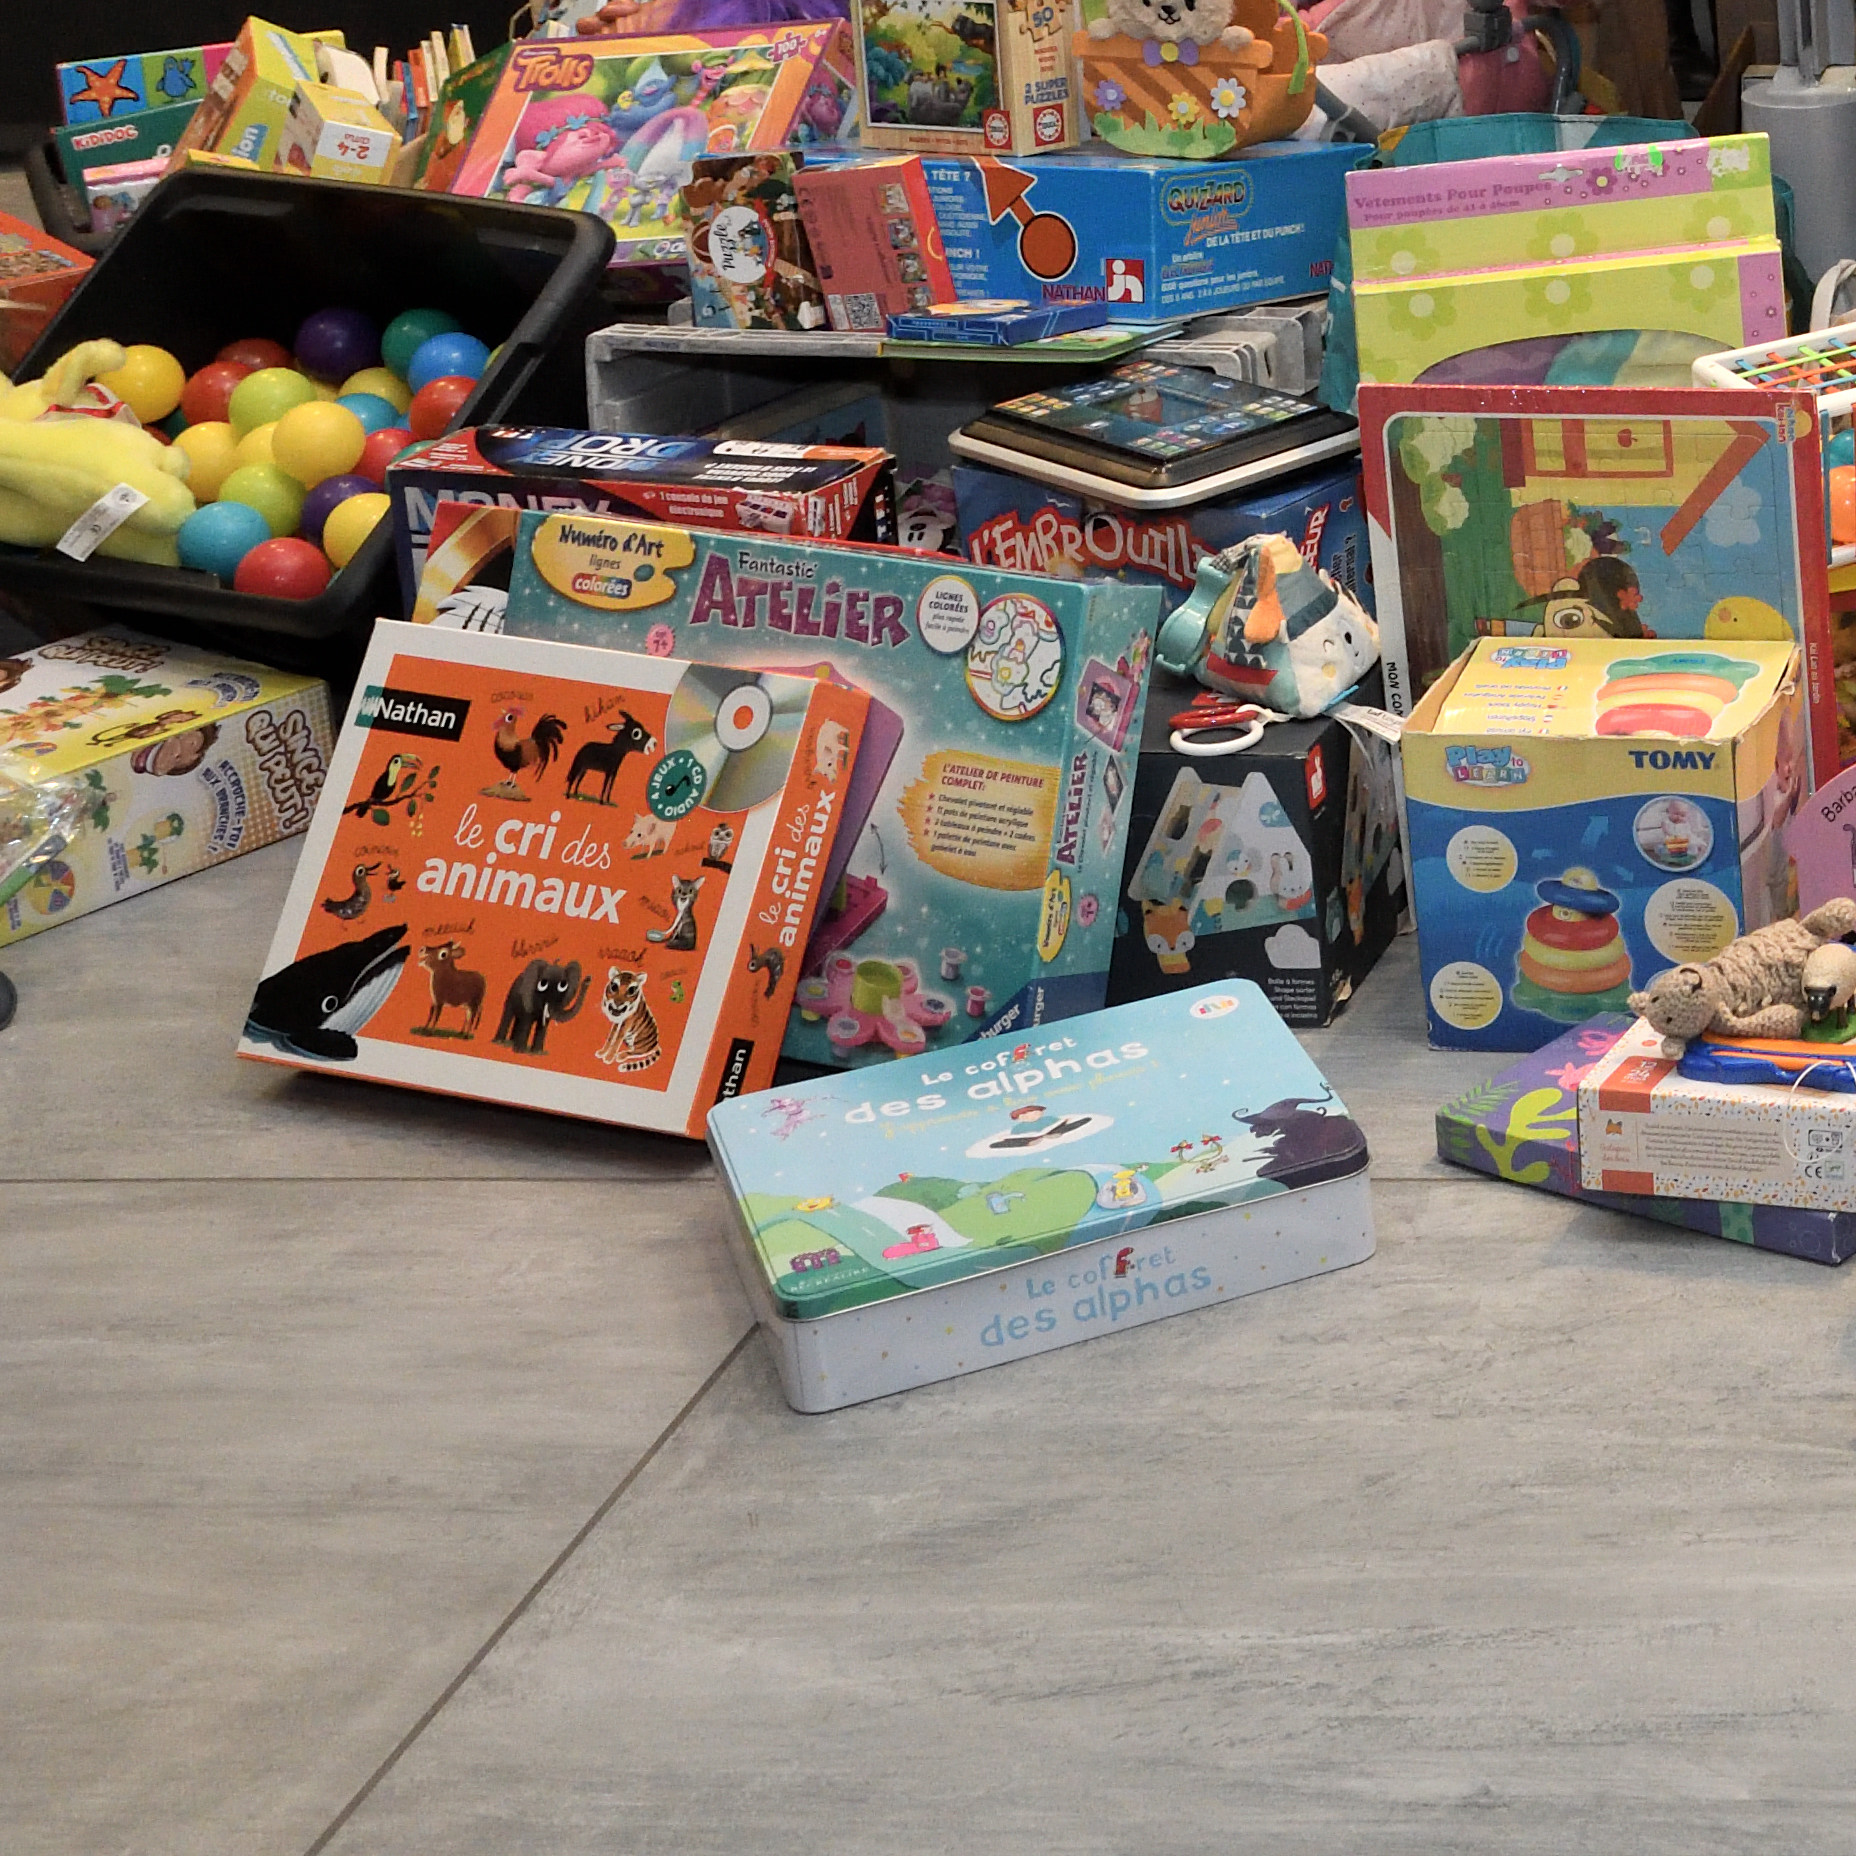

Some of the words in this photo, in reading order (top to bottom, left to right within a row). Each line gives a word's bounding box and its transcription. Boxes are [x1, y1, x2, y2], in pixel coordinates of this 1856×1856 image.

[1168, 179, 1246, 212] QUIZZARD
[1042, 284, 1106, 302] NATHAN
[559, 524, 618, 552] Numéro
[622, 529, 664, 559] d'Art
[589, 556, 621, 572] lignes
[573, 575, 631, 597] colorées
[935, 590, 964, 603] LIGNES
[374, 696, 457, 732] Nathan
[1445, 744, 1513, 768] Play
[1628, 750, 1716, 770] TOMY
[653, 756, 677, 789] JEUX
[1000, 771, 1045, 789] PEINTURE
[664, 788, 700, 818] AUDIO
[453, 805, 488, 850] le
[494, 810, 561, 860] cri
[562, 836, 611, 870] des
[771, 842, 800, 893] cri
[791, 802, 811, 841] des
[777, 789, 837, 948] animaux
[416, 854, 628, 926] animaux
[844, 1088, 945, 1125] des
[966, 1037, 1151, 1102] alphas
[921, 1068, 954, 1086] Le
[1026, 1275, 1057, 1299] Le
[979, 1299, 1057, 1348] des
[1073, 1264, 1212, 1325] alphas
